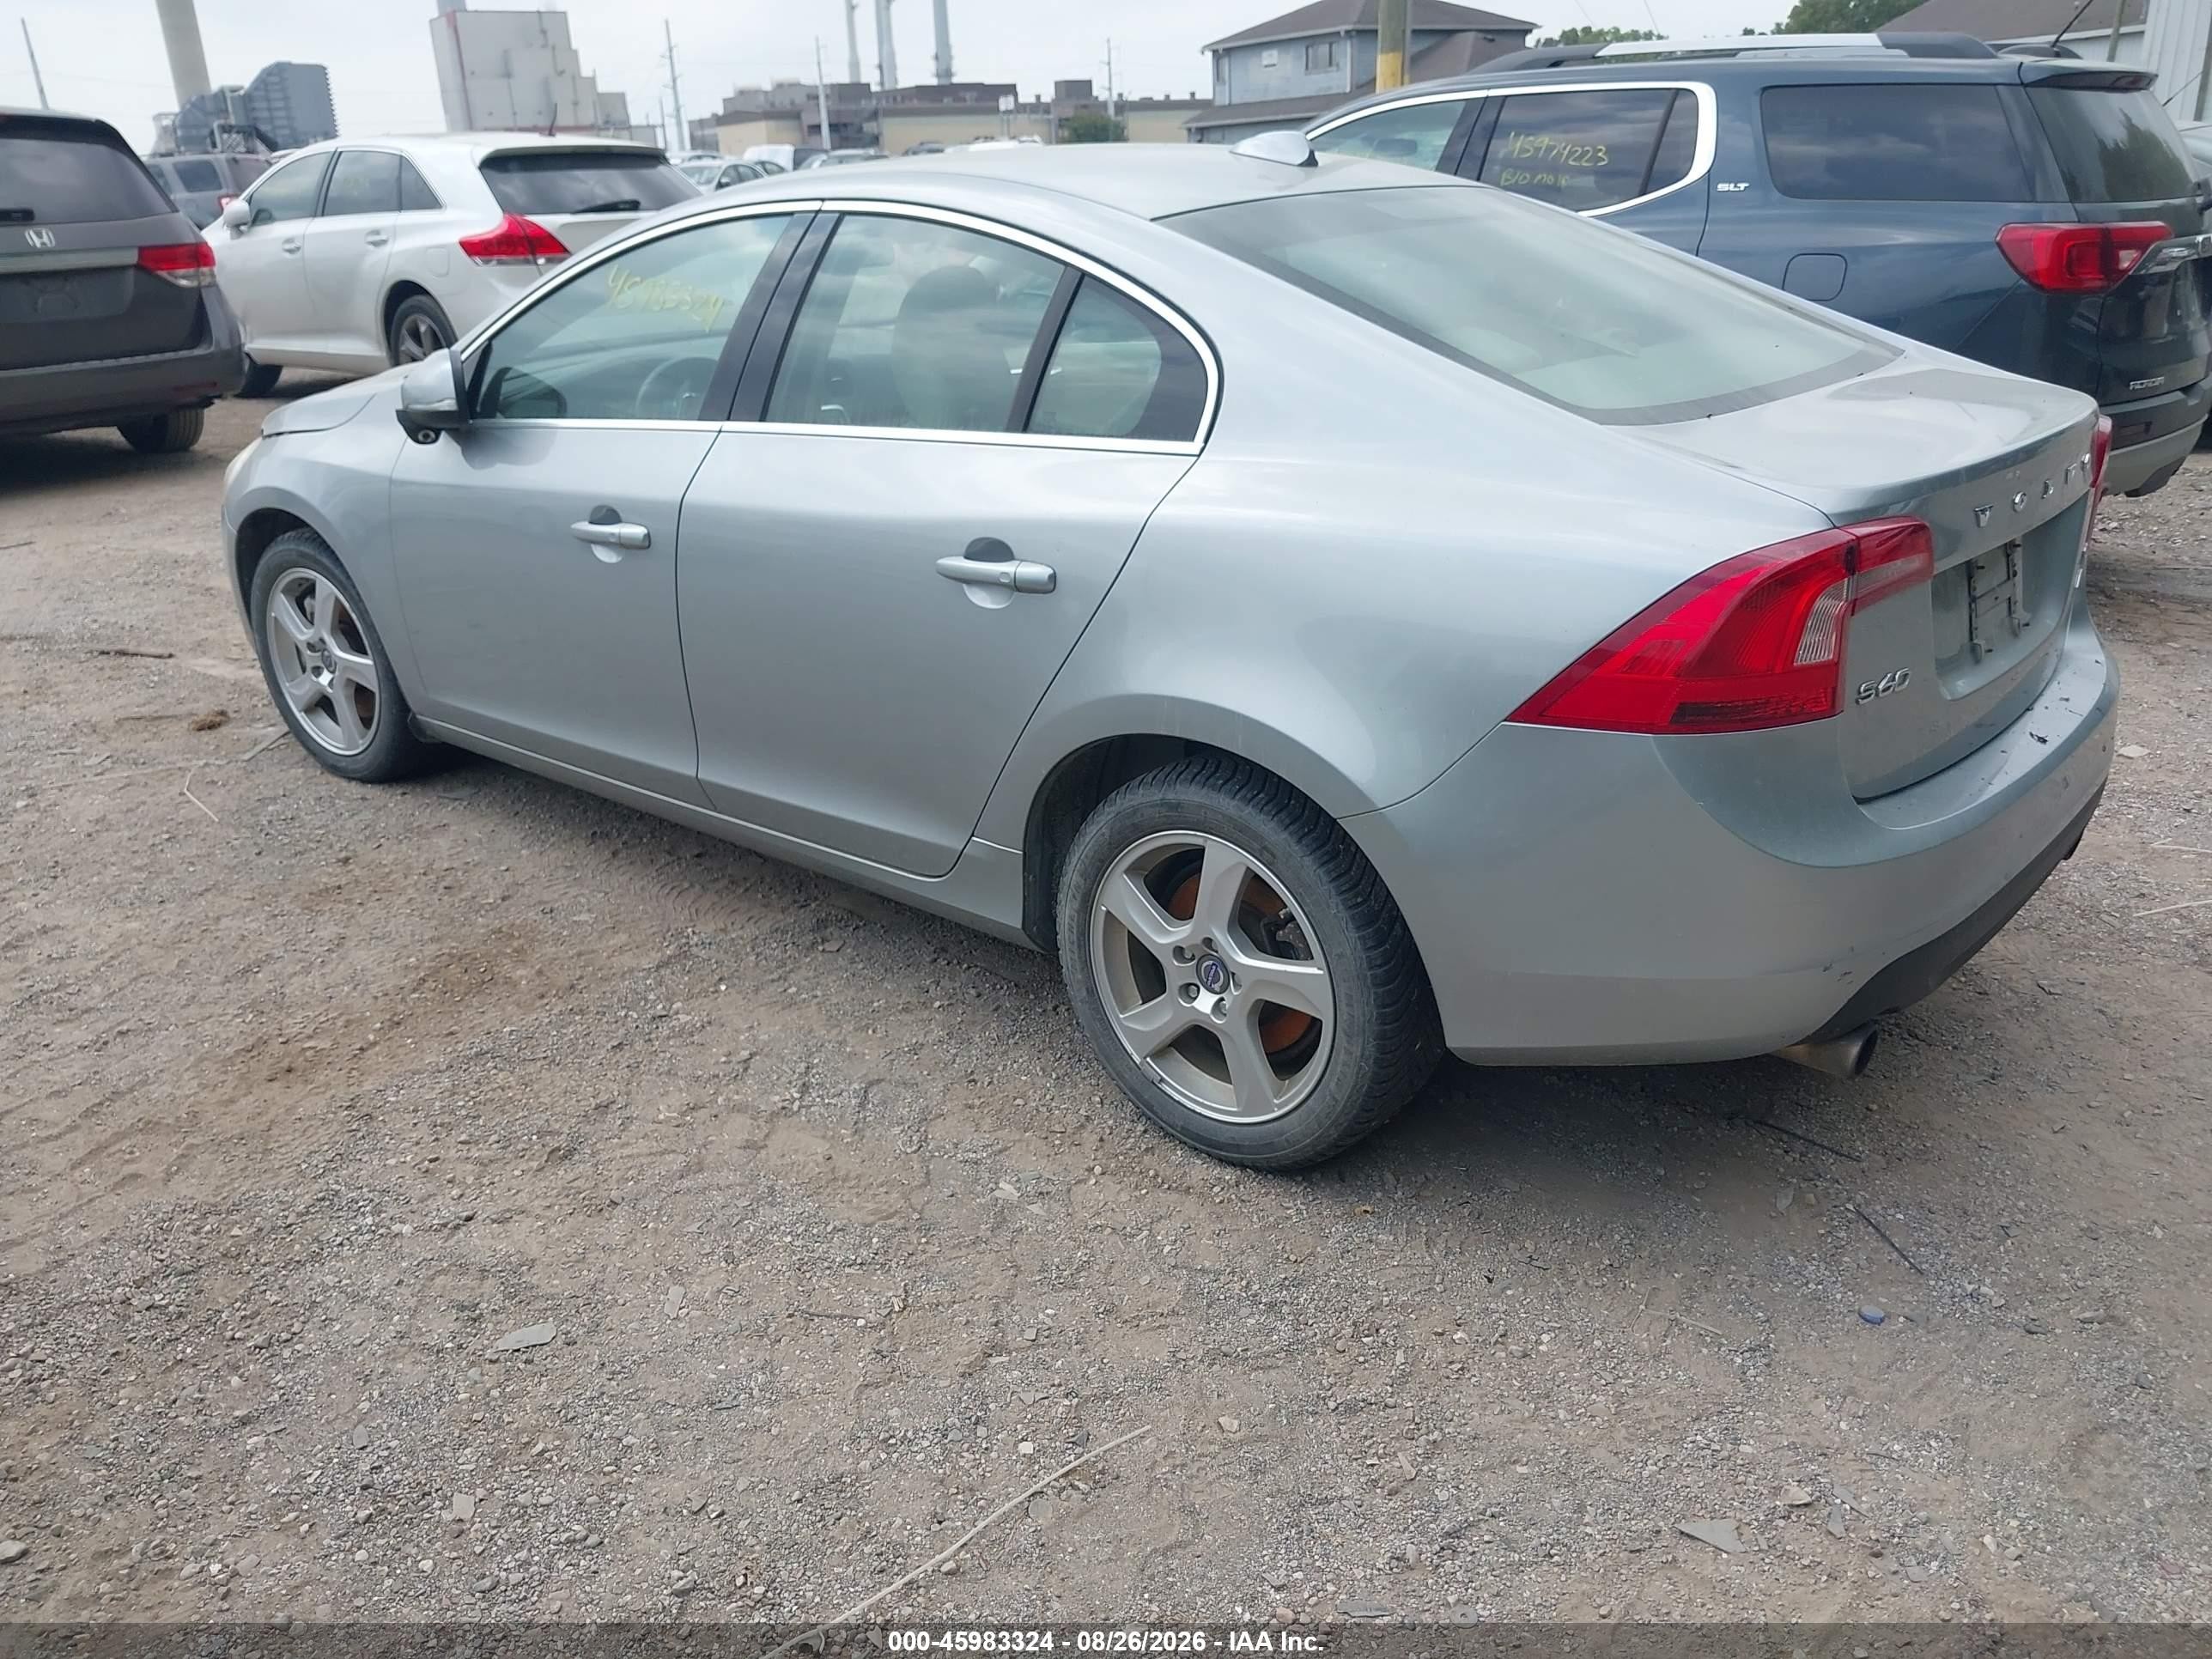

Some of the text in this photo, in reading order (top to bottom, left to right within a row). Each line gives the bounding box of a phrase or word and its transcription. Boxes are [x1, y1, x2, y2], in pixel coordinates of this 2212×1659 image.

[1504, 131, 1608, 167] 45974223
[1716, 182, 1750, 192] SLT
[1855, 667, 1911, 706] S60
